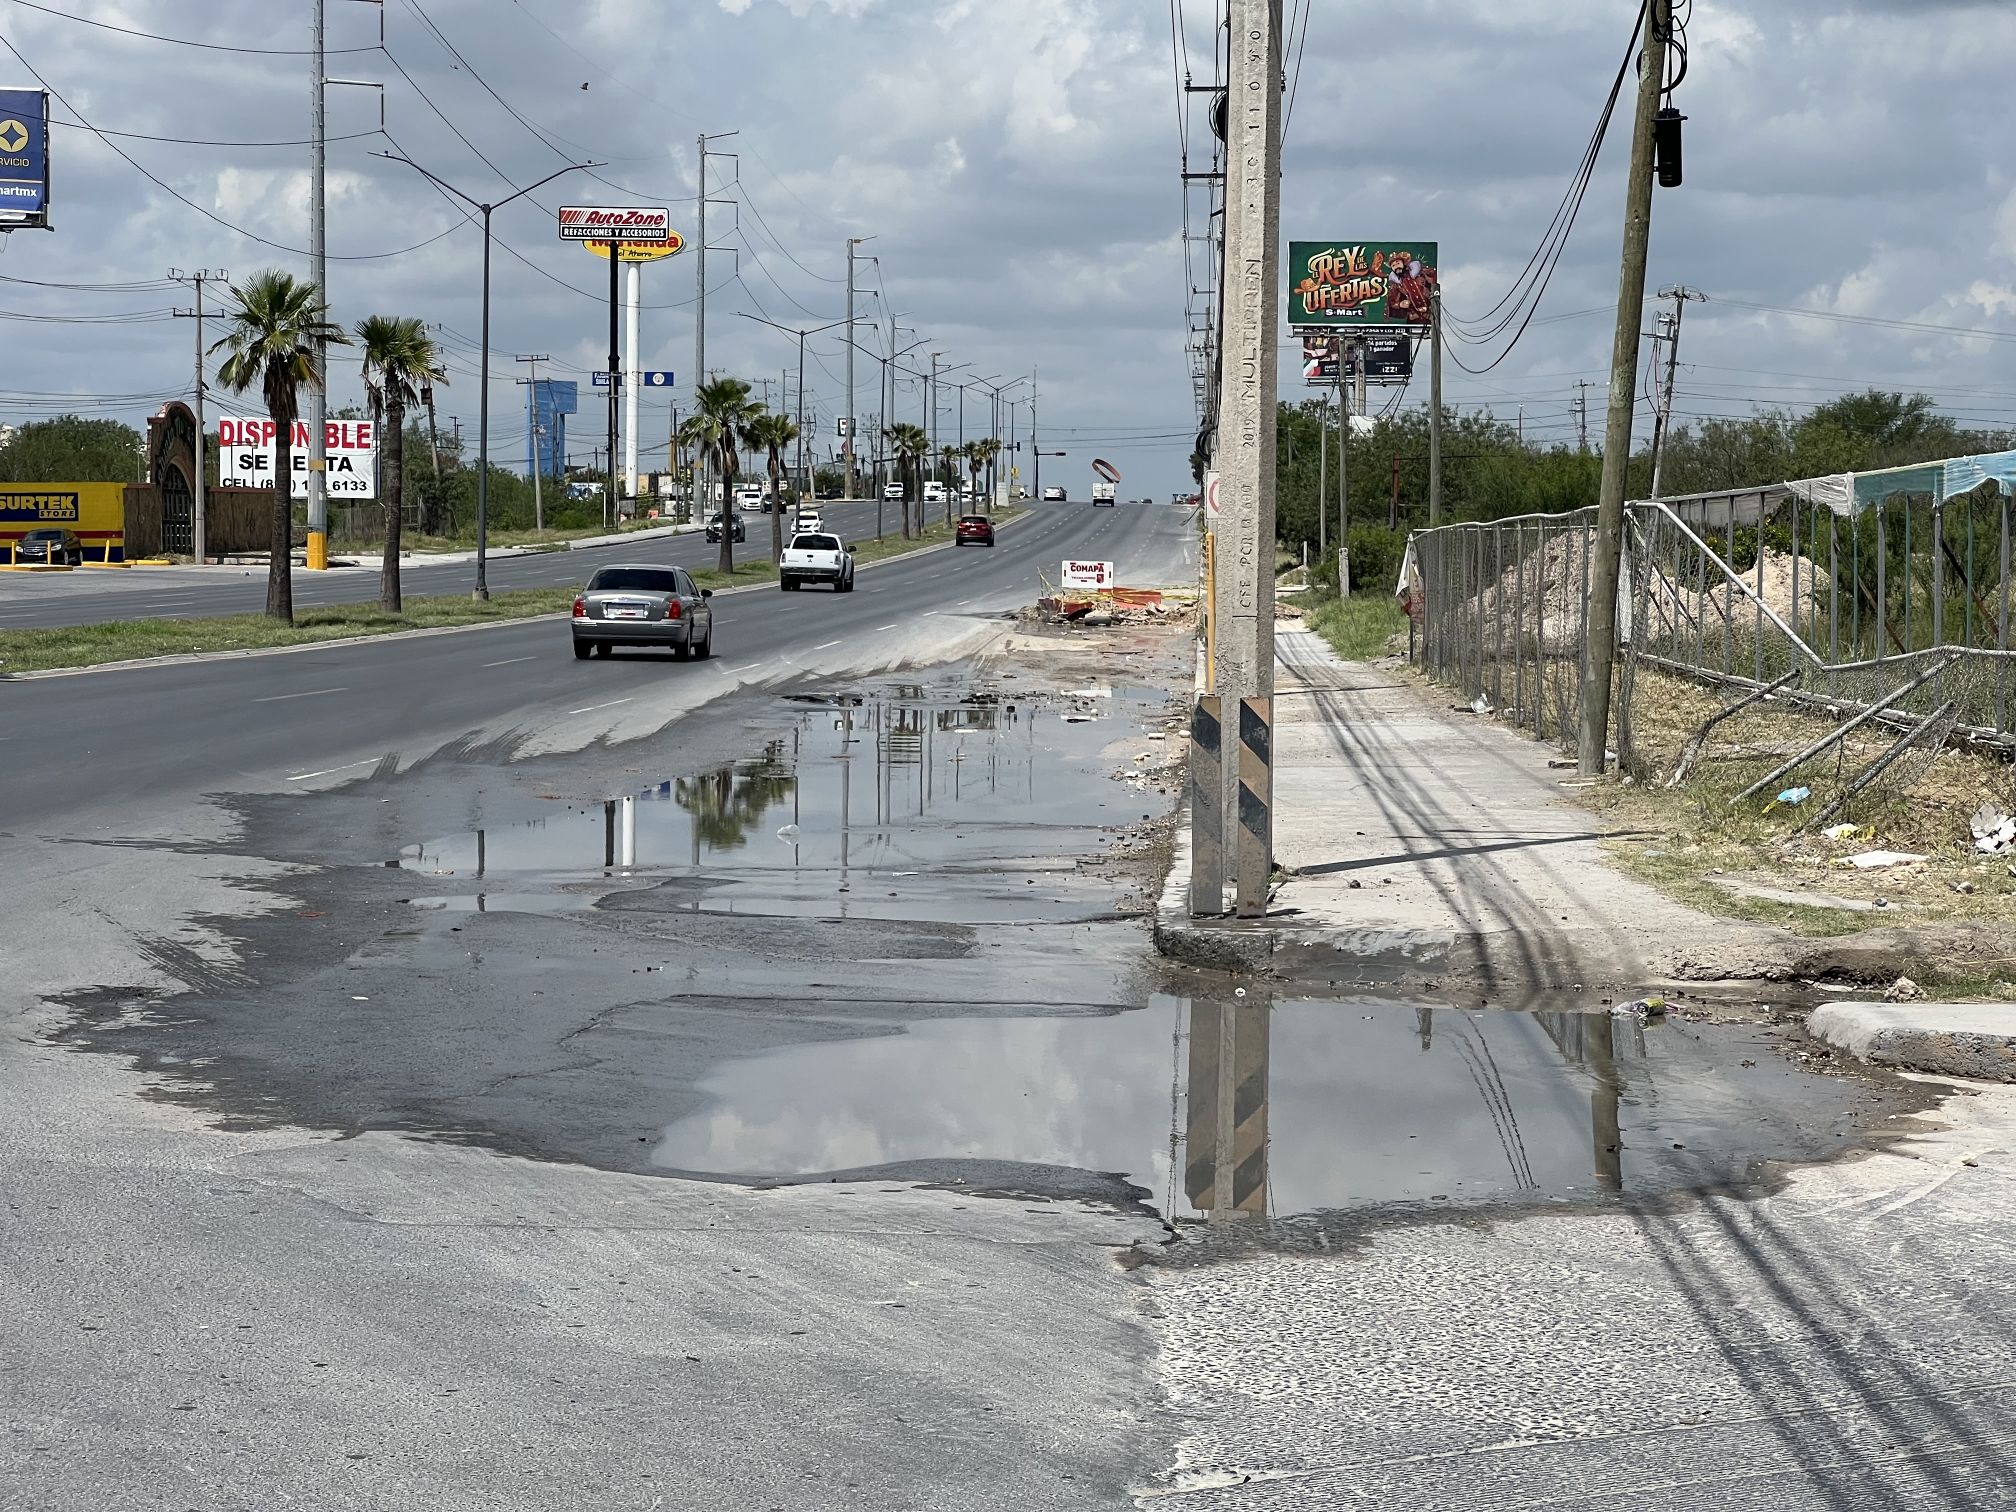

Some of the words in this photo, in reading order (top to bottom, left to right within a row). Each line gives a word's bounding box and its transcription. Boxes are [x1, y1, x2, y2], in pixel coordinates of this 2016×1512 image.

[585, 211, 666, 226] AutoZone
[563, 228, 612, 237] REFACCIONES
[621, 228, 665, 237] ACCESORIOS
[1311, 245, 1368, 285] REY
[220, 420, 371, 449] DISPNBLE
[239, 454, 268, 470] SE
[293, 455, 354, 472] ETA
[332, 480, 368, 491] 6133
[1070, 565, 1105, 573] COMAPA
